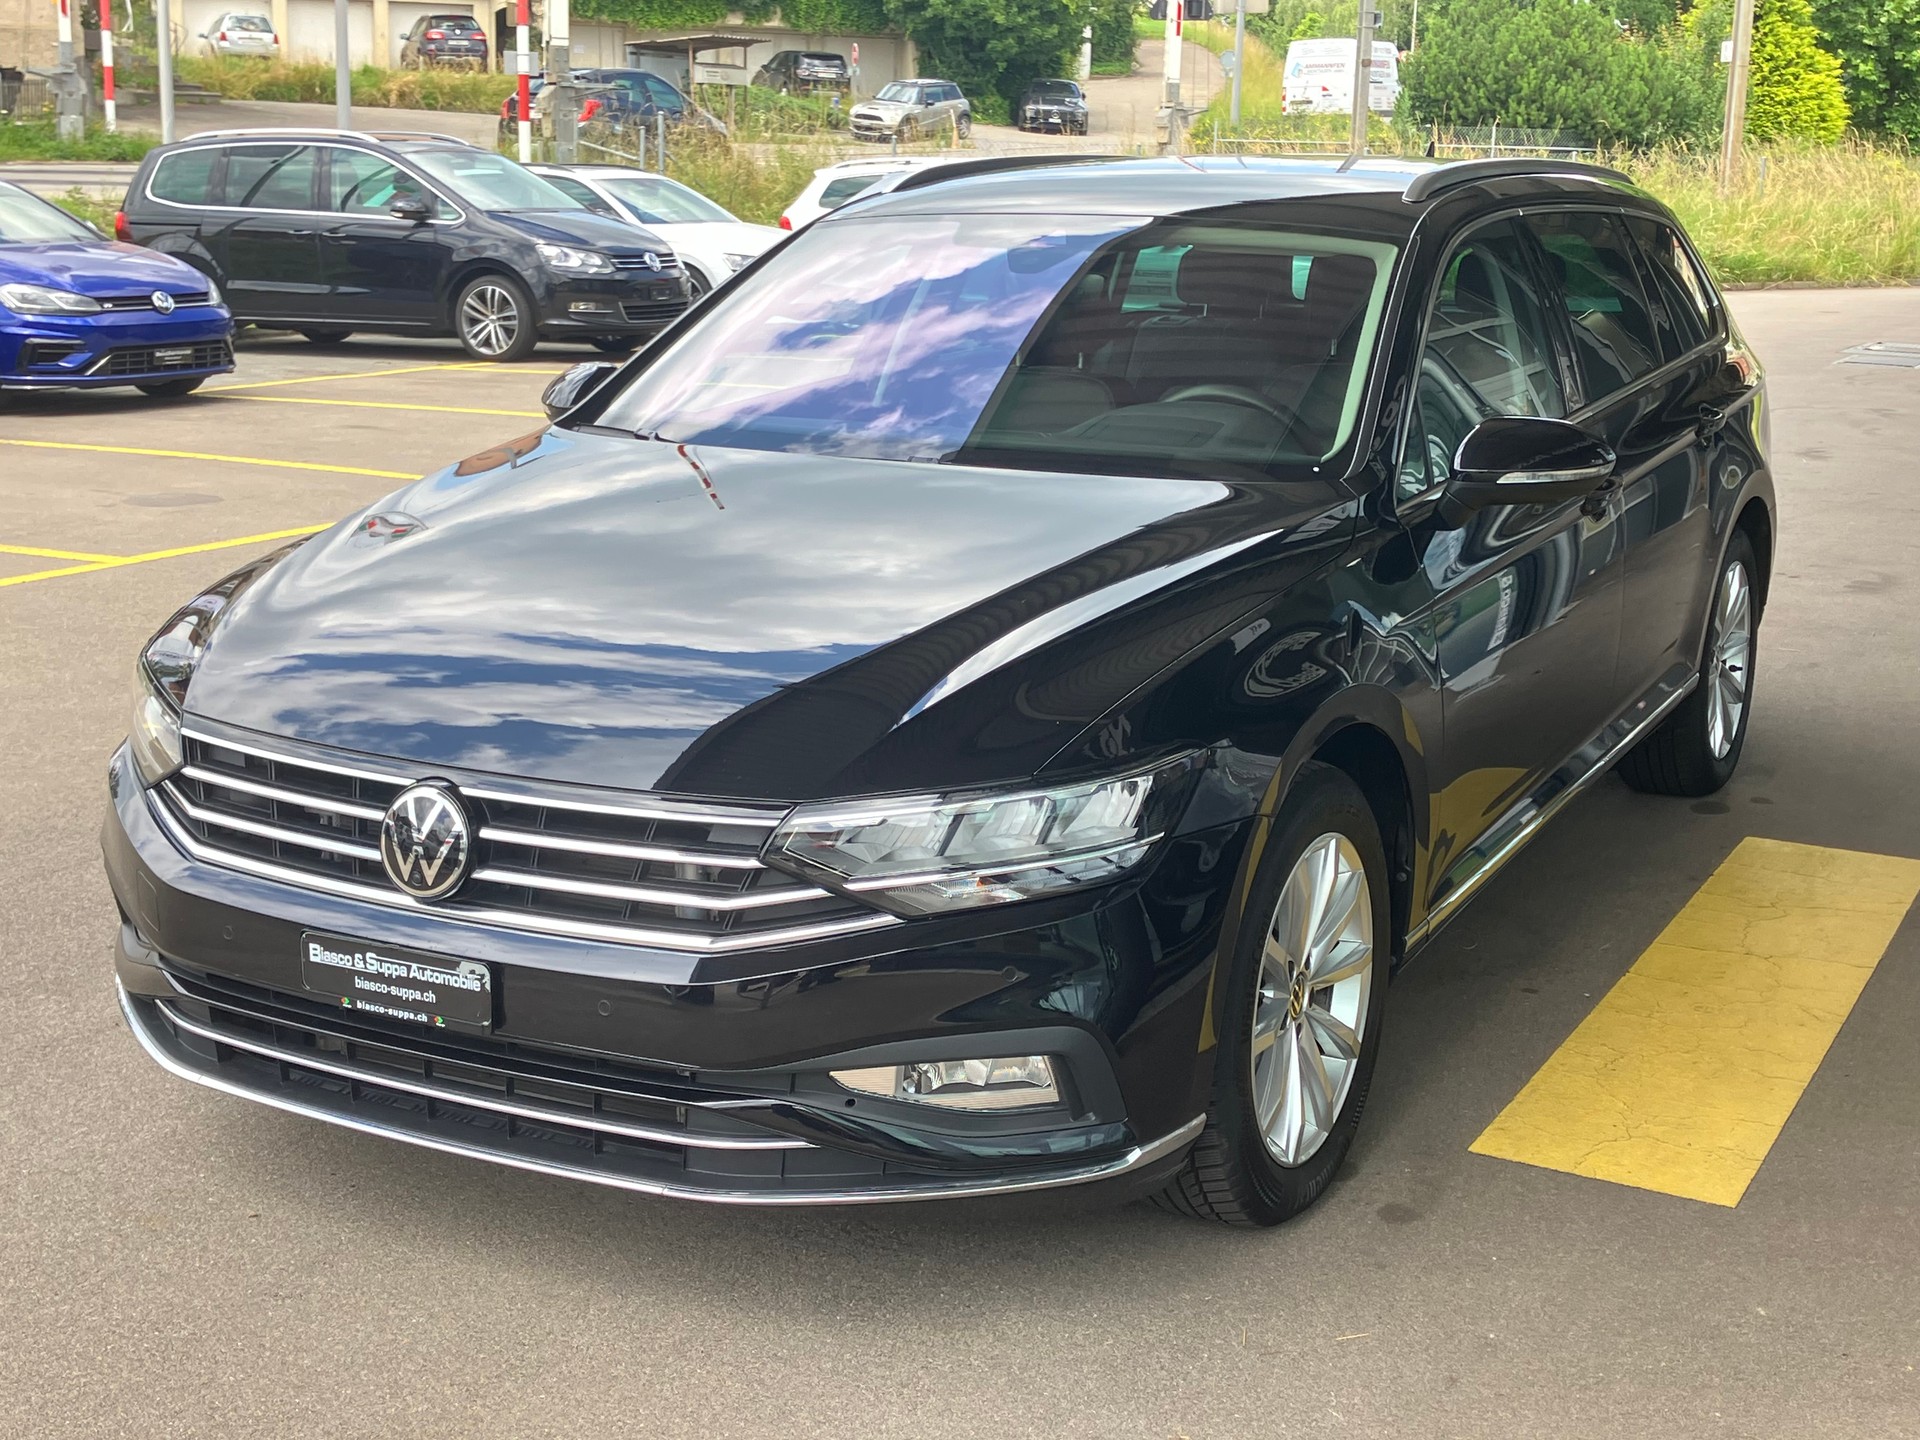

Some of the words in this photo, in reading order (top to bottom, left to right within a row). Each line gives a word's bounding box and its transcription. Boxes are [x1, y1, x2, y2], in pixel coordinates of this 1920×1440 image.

[308, 943, 353, 967] Biasco
[354, 953, 365, 969] &
[365, 952, 408, 979] Suppa
[409, 963, 481, 992] Automobile
[354, 975, 436, 1003] biasco-suppa.ch
[356, 1000, 428, 1023] biasco-suppa.ch
